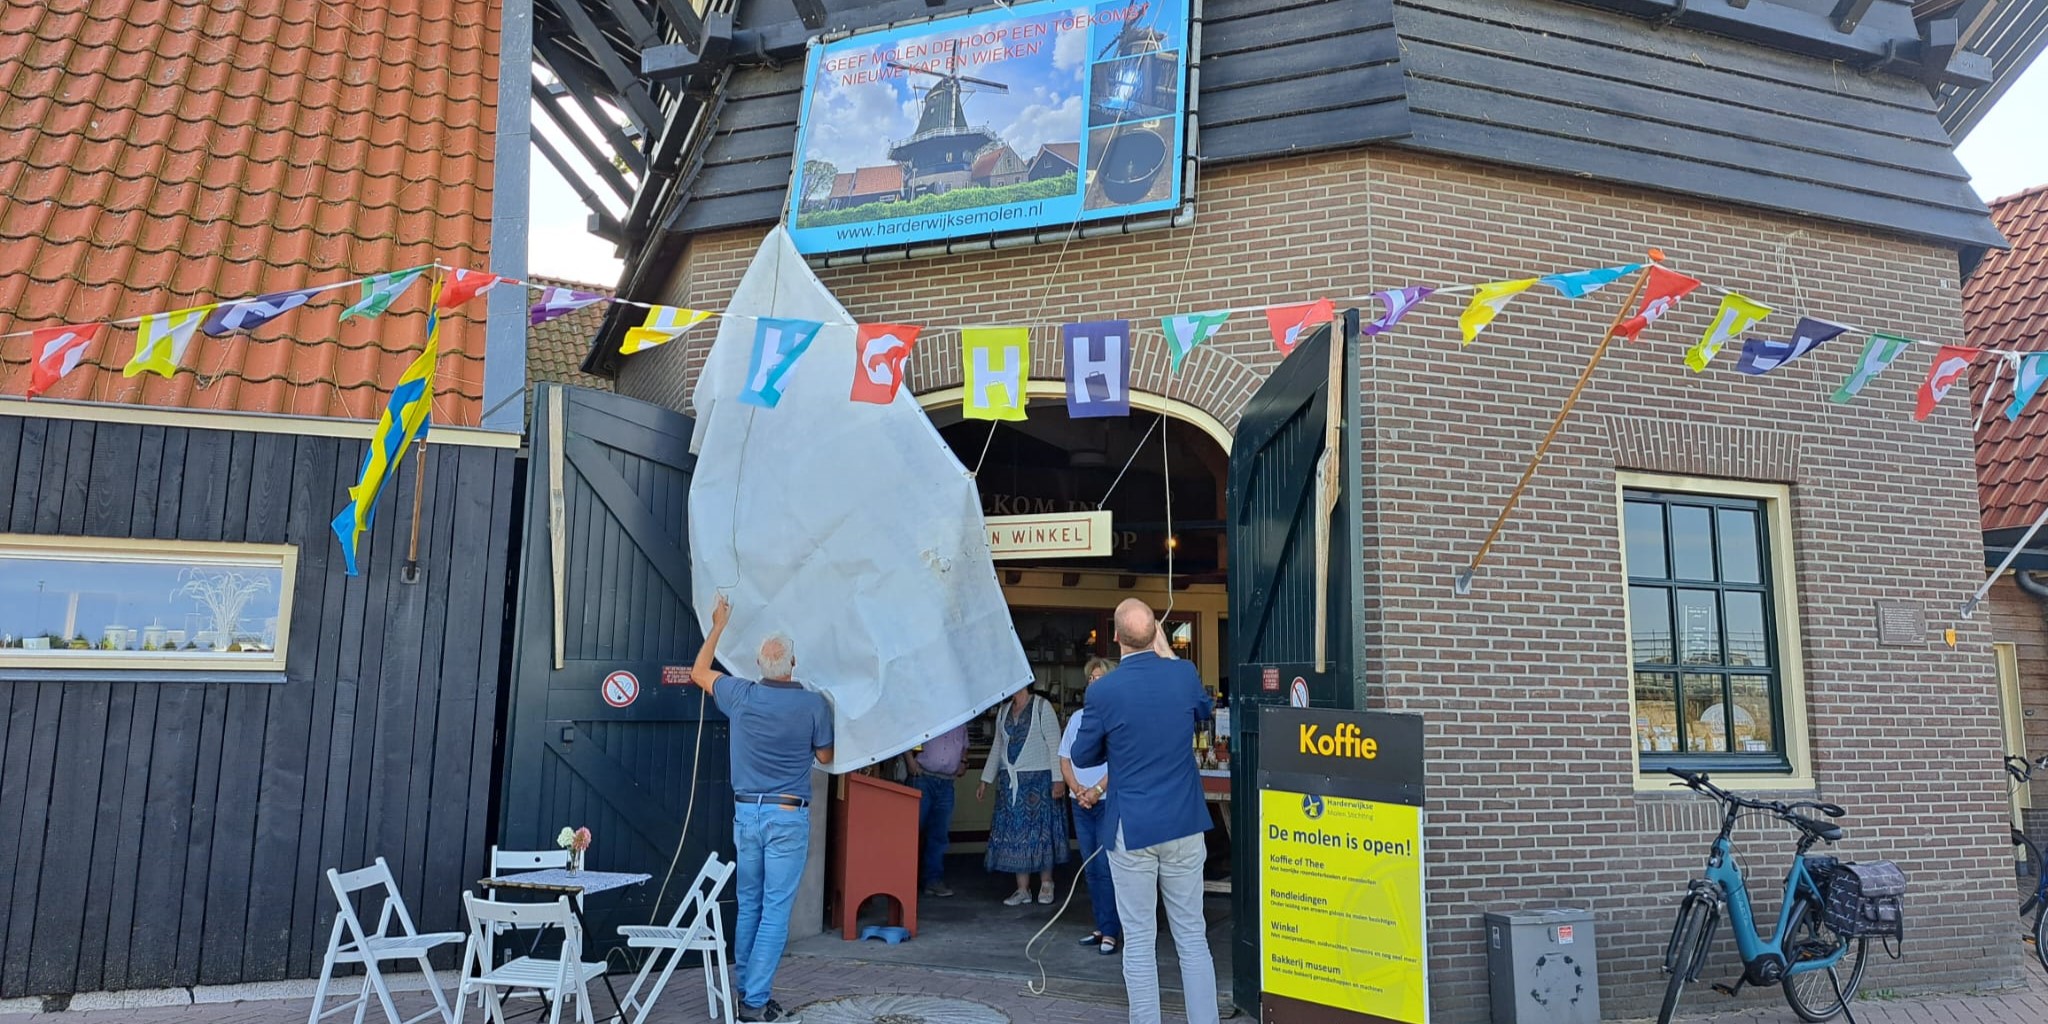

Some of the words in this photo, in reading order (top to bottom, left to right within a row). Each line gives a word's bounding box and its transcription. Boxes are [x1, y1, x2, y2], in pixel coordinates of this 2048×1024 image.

[871, 44, 928, 68] MOLEN
[932, 39, 953, 55] DE
[958, 29, 1008, 49] HOOP
[1012, 23, 1047, 40] EEN
[842, 66, 903, 87] NIEUWE
[909, 59, 941, 75] KAP
[945, 54, 968, 69] EN
[836, 202, 1043, 240] www.harderwijksemolen.nl
[973, 346, 1020, 408] H
[1073, 336, 1121, 404] H
[1299, 722, 1378, 760] Koffie
[1327, 799, 1374, 811] Harderwijkse
[1269, 824, 1289, 841] De
[1293, 828, 1341, 847] molen
[1346, 833, 1358, 849] is
[1363, 839, 1411, 856] open!
[1270, 854, 1293, 865] Koffie
[1294, 858, 1303, 866] of
[1305, 858, 1325, 869] Thee
[1270, 888, 1327, 906] Rondleidingen
[1271, 921, 1298, 934] Winkel
[1271, 953, 1304, 970] Bakkerij
[1305, 961, 1341, 975] museum
